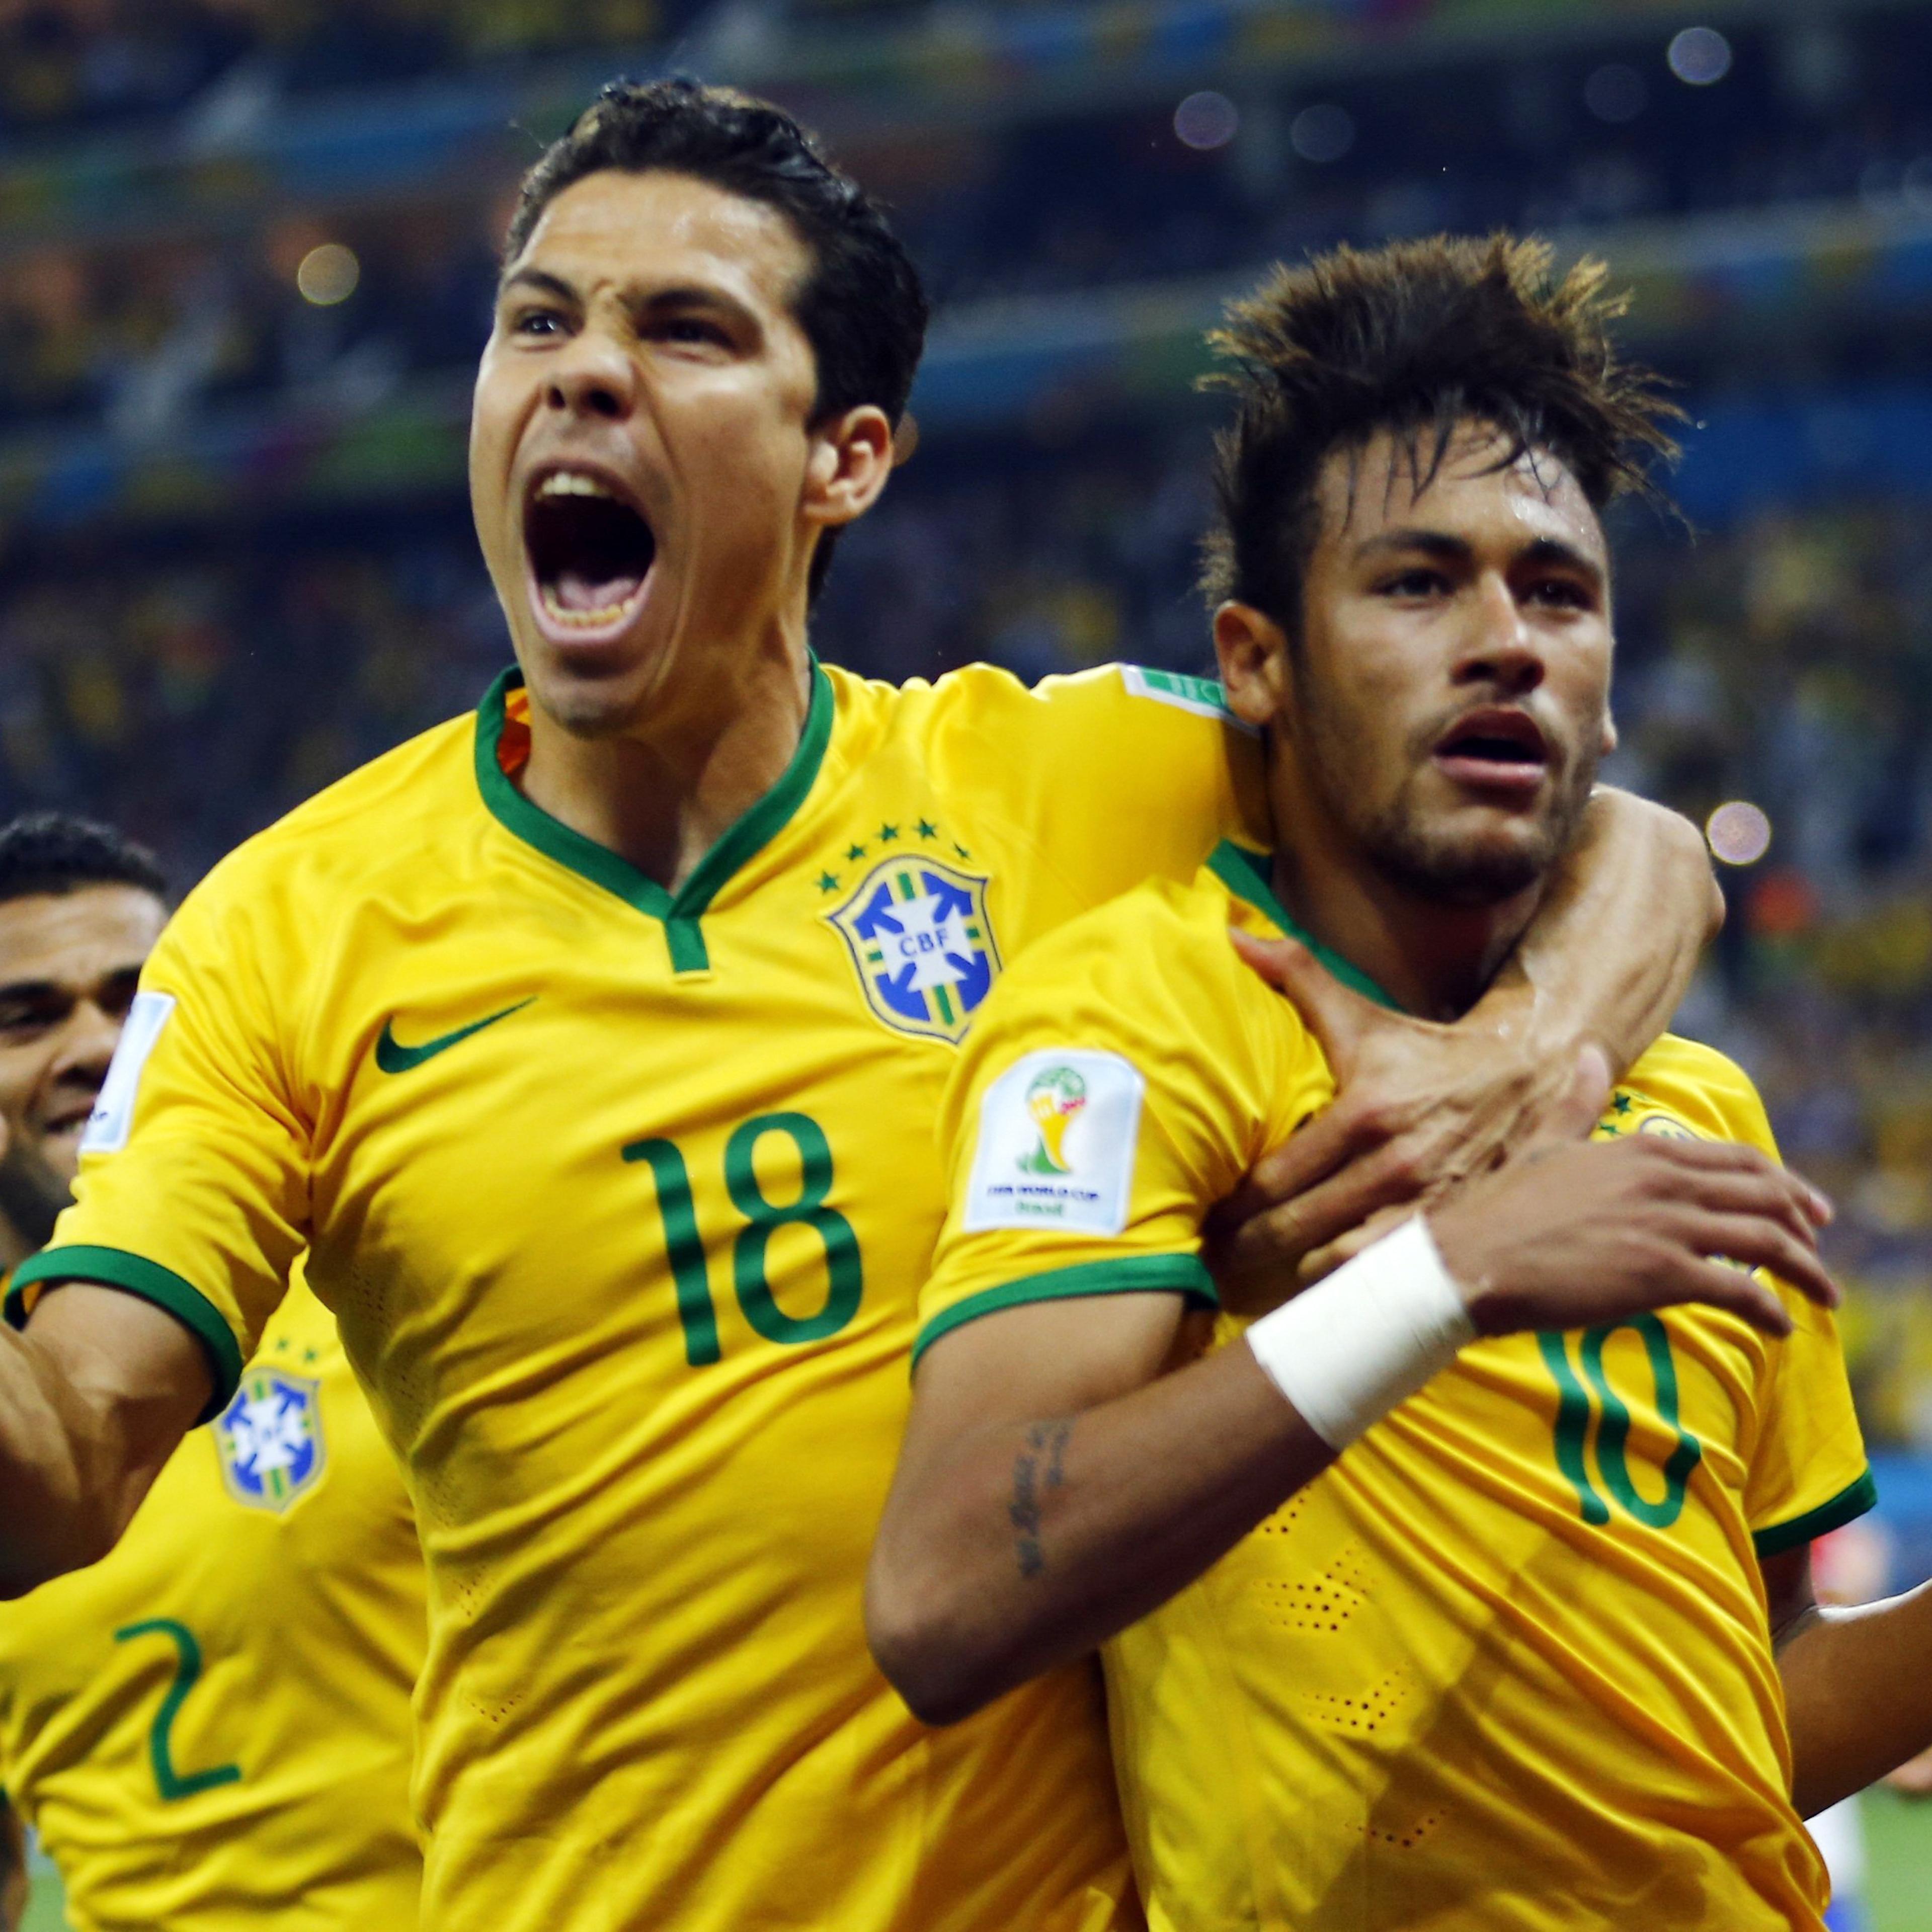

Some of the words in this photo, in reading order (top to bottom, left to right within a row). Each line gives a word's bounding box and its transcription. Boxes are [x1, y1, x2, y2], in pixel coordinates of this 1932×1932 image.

[899, 928, 950, 957] CBF
[621, 1111, 864, 1367] 18
[1535, 1312, 1701, 1528] 10
[114, 1618, 241, 1800] 2
